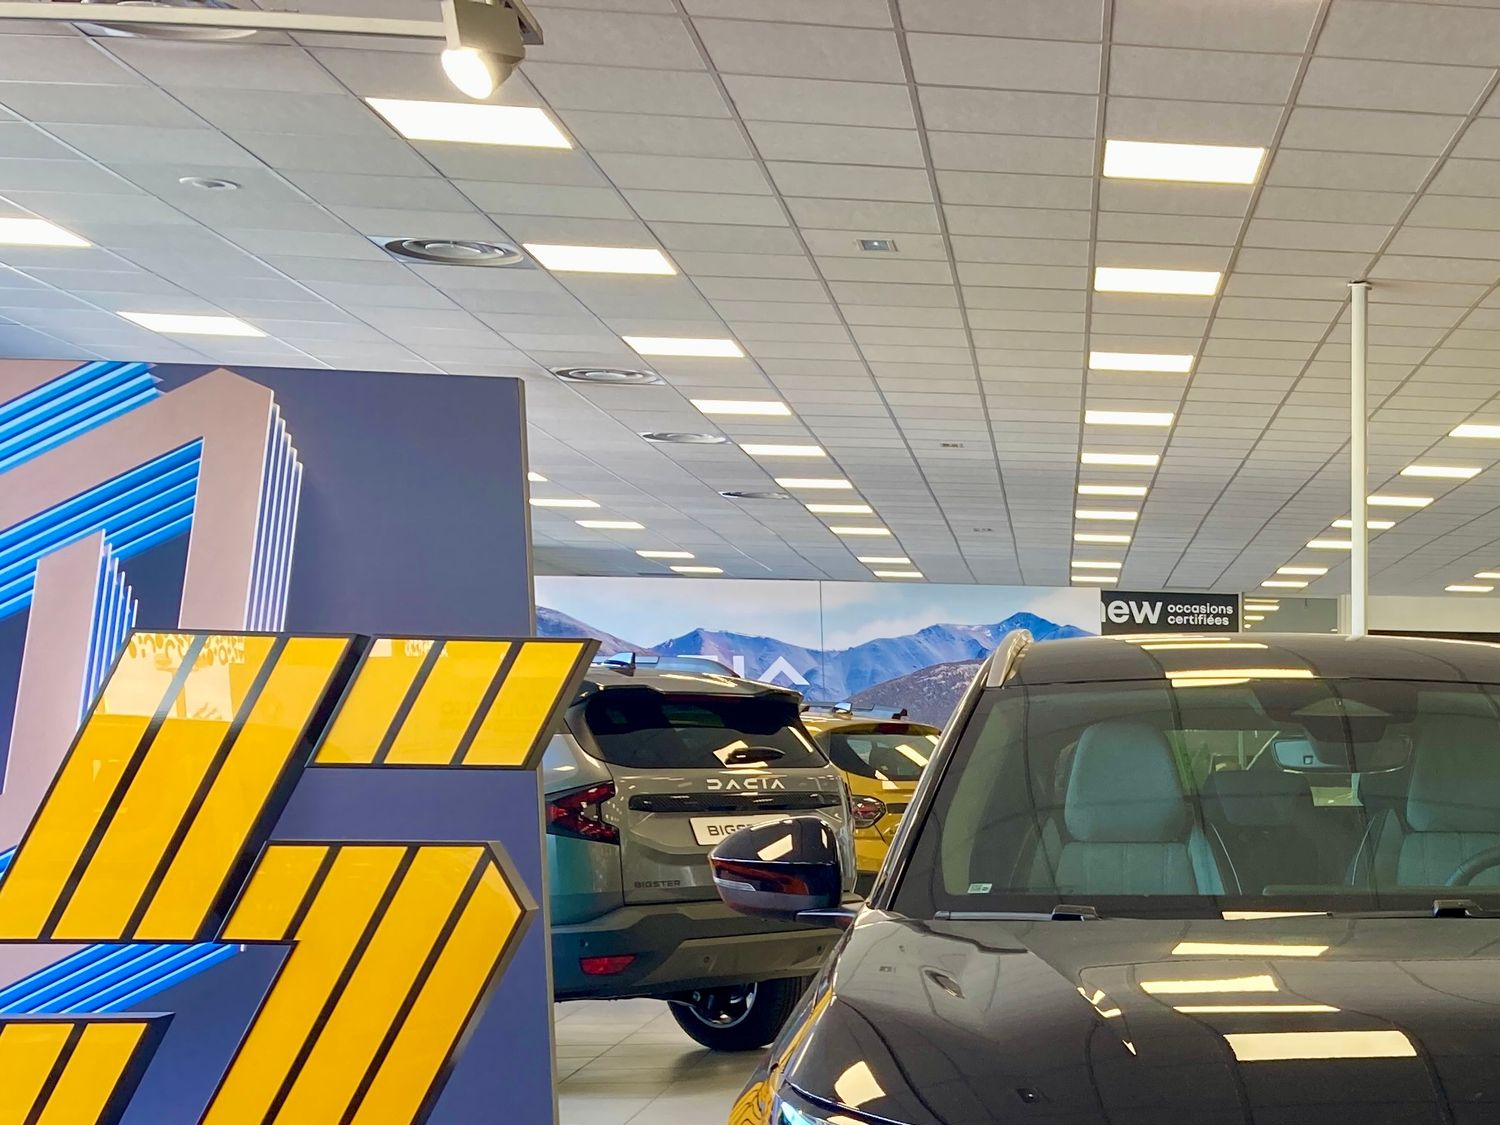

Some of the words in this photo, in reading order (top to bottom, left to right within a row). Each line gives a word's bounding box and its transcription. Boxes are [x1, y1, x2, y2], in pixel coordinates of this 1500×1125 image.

[1167, 602, 1234, 615] occasions
[1167, 614, 1230, 626] certifiées
[706, 778, 785, 790] DACIA
[634, 880, 681, 889] BIGSTER
